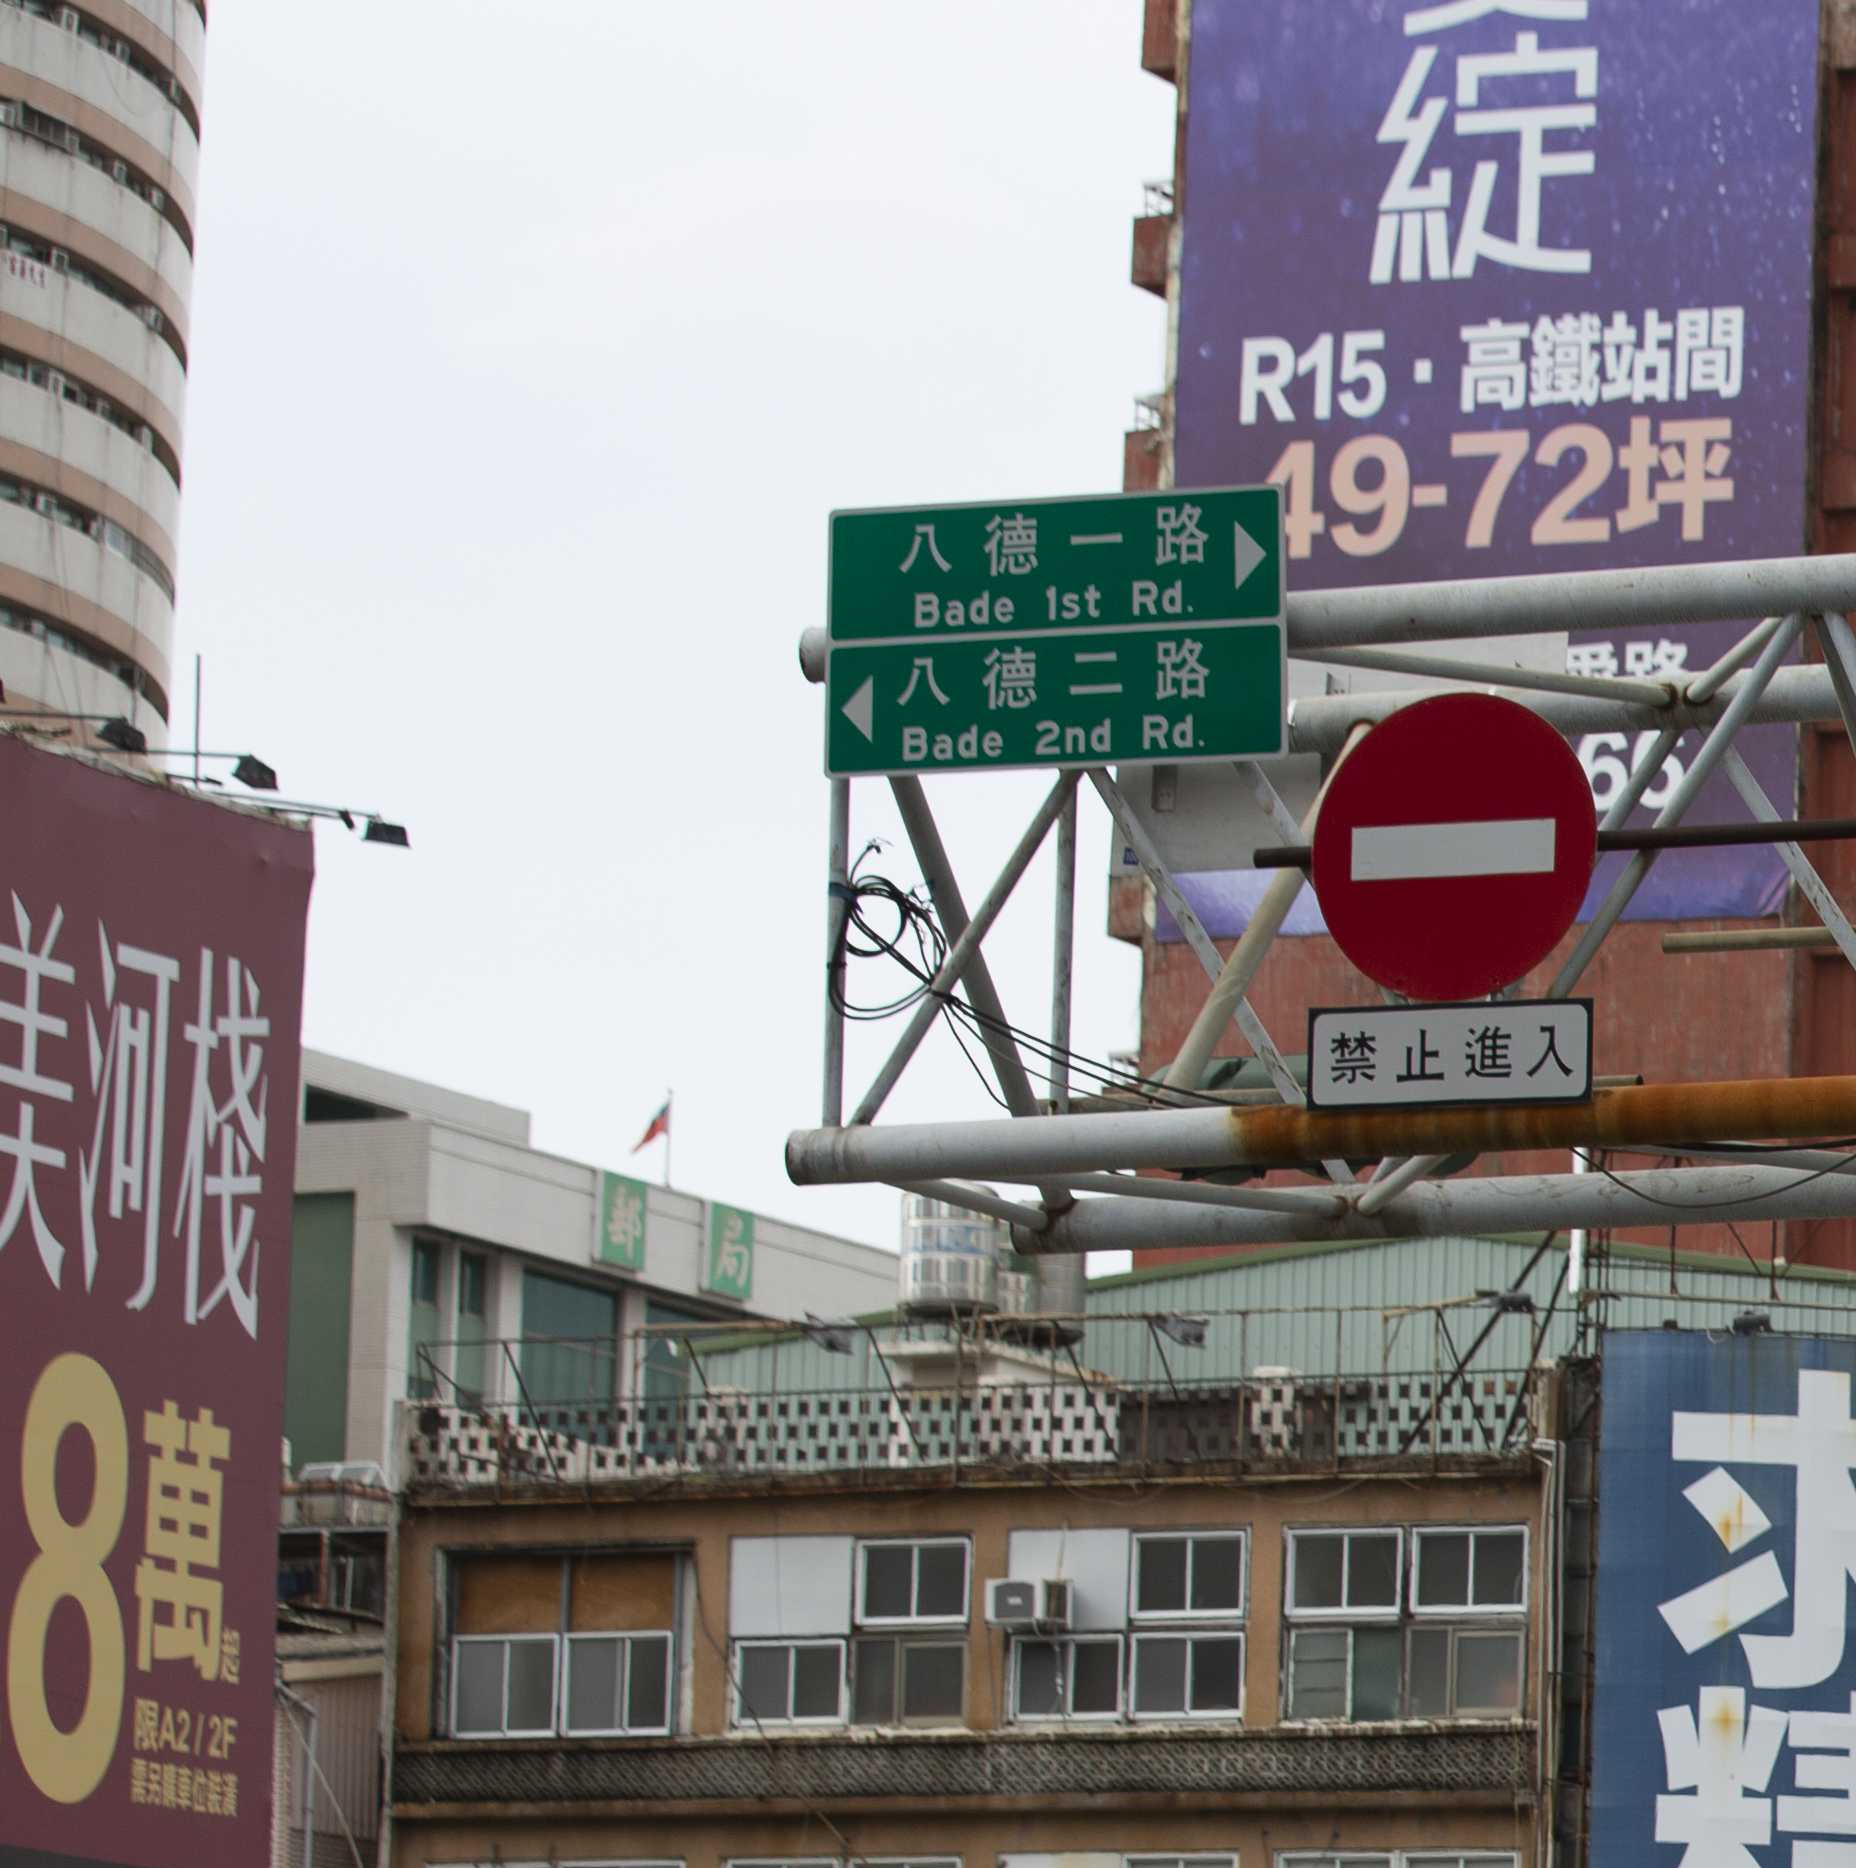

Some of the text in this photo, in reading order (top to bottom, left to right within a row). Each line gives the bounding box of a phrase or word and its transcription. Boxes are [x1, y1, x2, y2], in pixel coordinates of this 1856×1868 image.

[1239, 330, 1387, 425] R15
[1262, 416, 1735, 560] 49-72坪
[899, 503, 1208, 577] 八德一路
[914, 580, 1193, 628] Bade 1st Rd.
[898, 638, 1210, 710] 八德二路
[902, 714, 1204, 762] Bade 2nd Rd.
[1330, 1023, 1574, 1087] 禁止進入
[605, 1185, 752, 1288] 郵局
[208, 1714, 238, 1760] 2F
